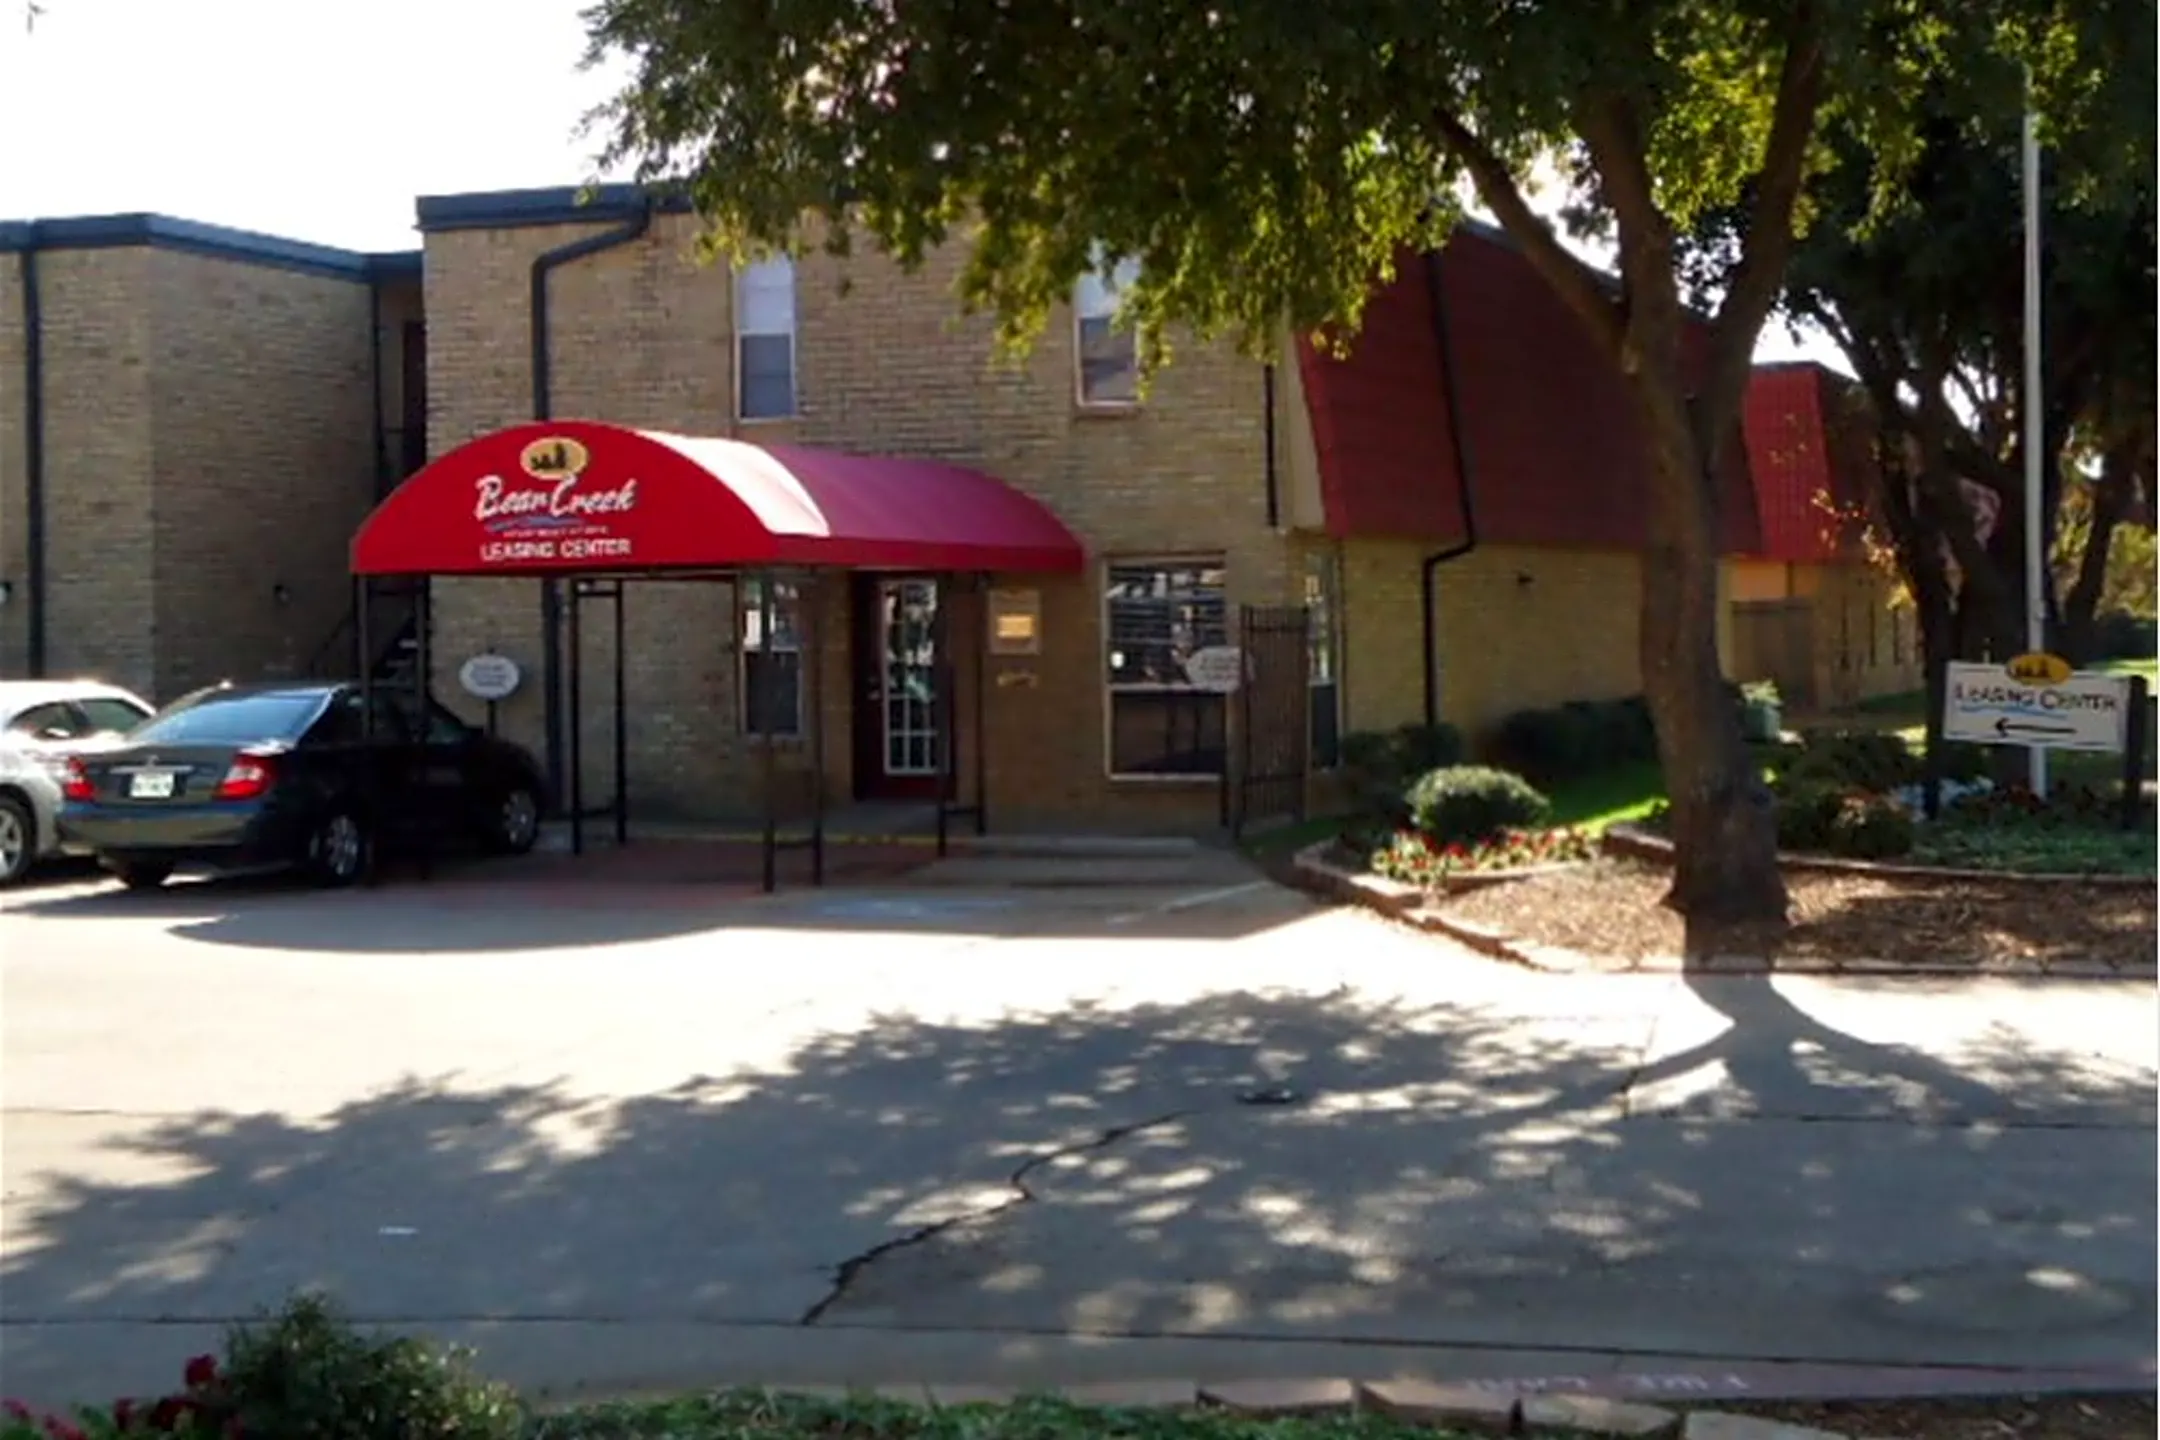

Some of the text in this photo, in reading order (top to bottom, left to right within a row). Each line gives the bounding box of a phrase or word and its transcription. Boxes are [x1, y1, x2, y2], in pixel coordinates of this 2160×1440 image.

[474, 473, 637, 521] Bear Creek
[480, 538, 632, 561] LEASING CENTER
